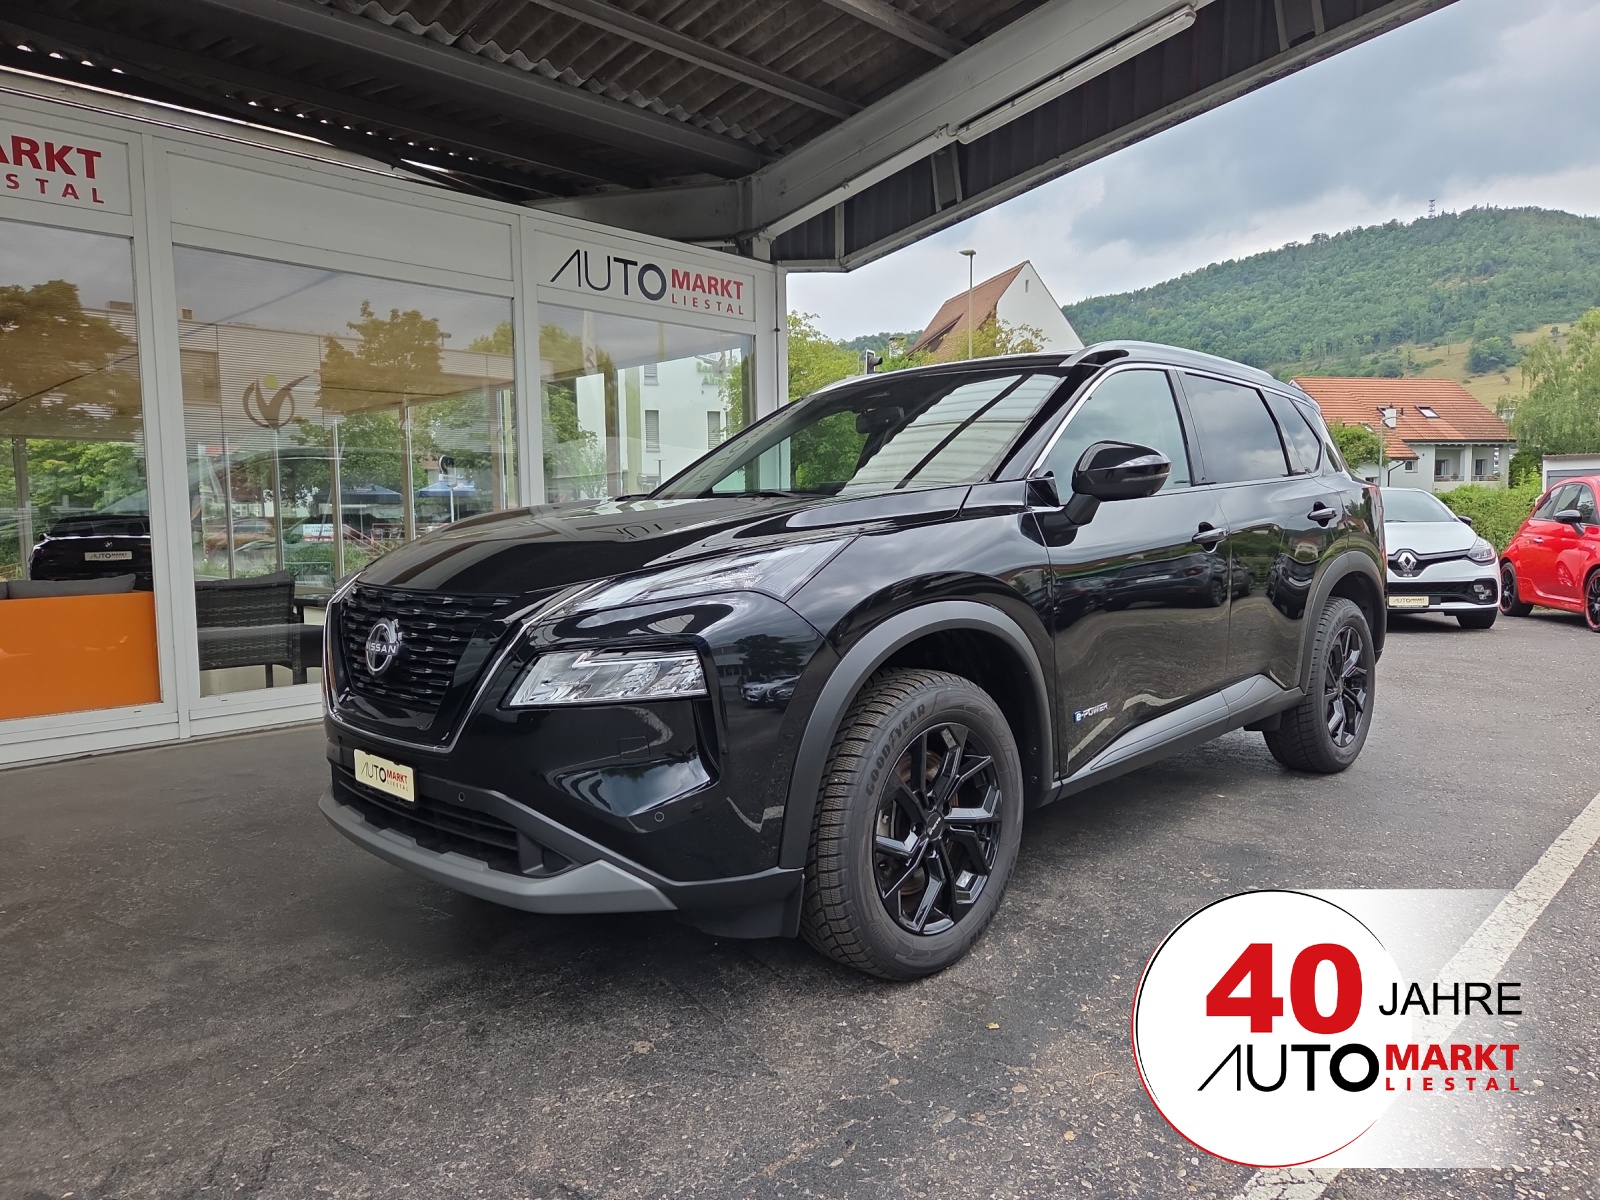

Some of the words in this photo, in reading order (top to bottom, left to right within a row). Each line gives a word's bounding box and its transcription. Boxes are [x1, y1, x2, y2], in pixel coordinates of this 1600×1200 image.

[0, 135, 102, 180] RKT
[671, 293, 744, 315] LIESTAL
[865, 703, 926, 798] GOODYEAR
